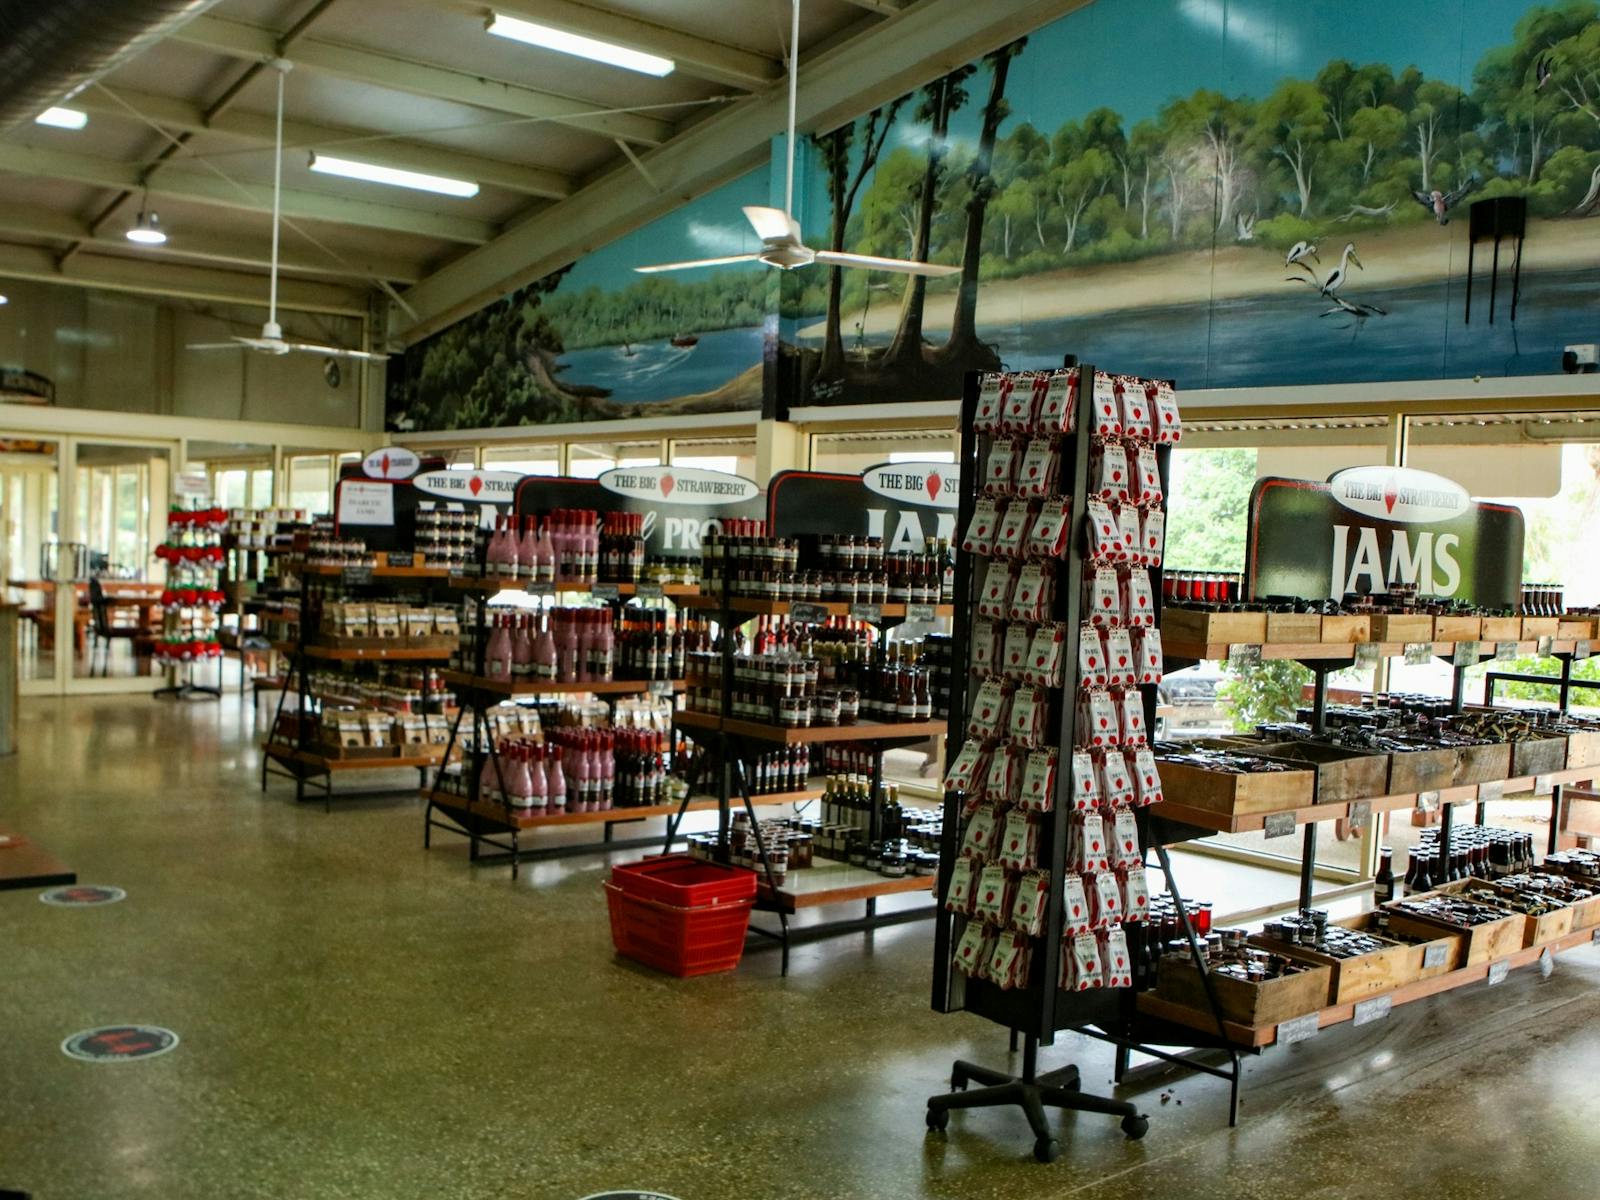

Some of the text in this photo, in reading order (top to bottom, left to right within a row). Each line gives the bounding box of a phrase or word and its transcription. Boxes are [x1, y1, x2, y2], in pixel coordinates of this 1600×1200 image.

[426, 476, 448, 488] THE
[450, 478, 466, 489] BIG
[614, 474, 747, 496] THE BIG STRAWBERRY
[879, 473, 903, 489] THE
[904, 475, 923, 491] BIG
[1344, 480, 1365, 500] THE
[1366, 484, 1382, 502] BIG
[1330, 524, 1461, 607] JAMS
